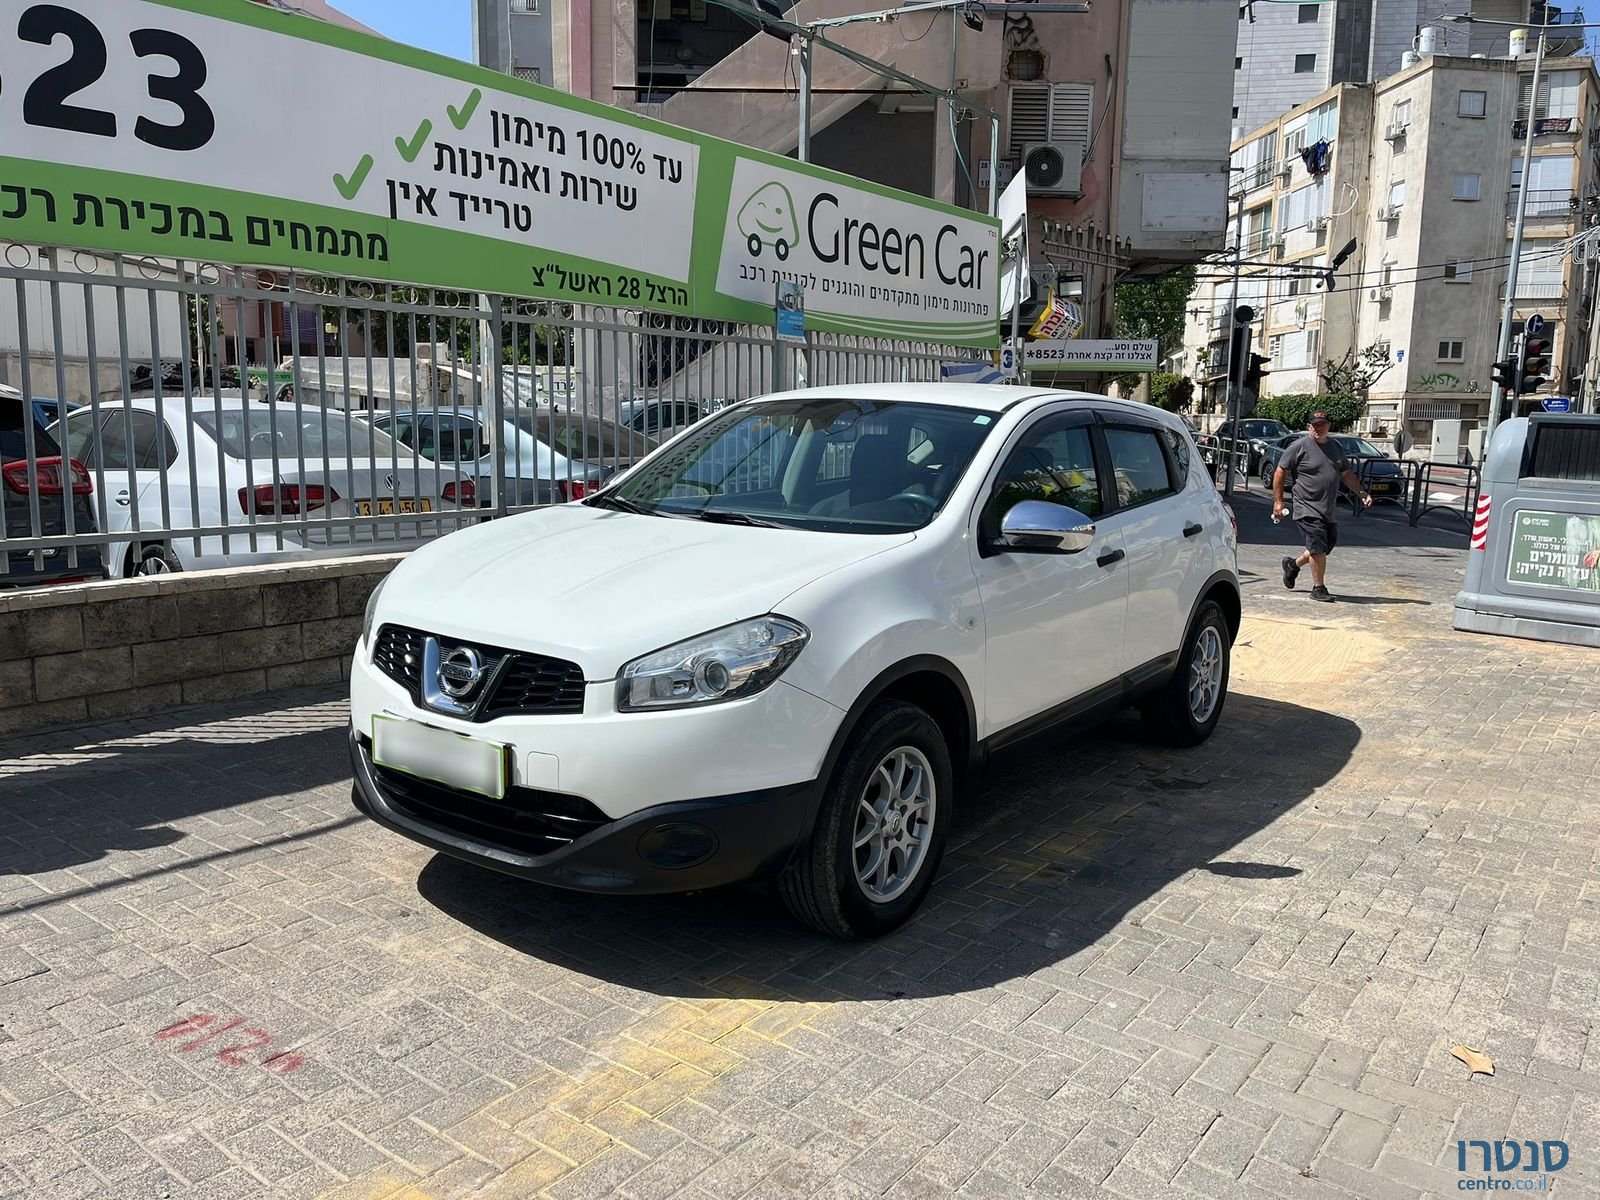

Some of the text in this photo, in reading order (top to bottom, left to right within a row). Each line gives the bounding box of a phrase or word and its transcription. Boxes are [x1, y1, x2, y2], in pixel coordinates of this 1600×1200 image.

[490, 109, 683, 184] עד 100% מימון
[433, 141, 637, 212] שירות ואמינות
[386, 178, 532, 232] טרייד אין
[72, 192, 234, 242] במכירת
[245, 215, 389, 261] מתמחים
[807, 192, 989, 290] Green Car
[739, 263, 767, 283] רכב
[617, 275, 640, 300] 28
[645, 278, 688, 306] הרצל
[822, 278, 866, 298] והוגנים
[869, 286, 920, 308] מתקדמים
[923, 294, 950, 311] מימון
[952, 299, 989, 316] פתרונות
[1115, 352, 1125, 360] זה
[1127, 351, 1152, 360] אצלנו
[1132, 341, 1153, 351] שלם
[1067, 352, 1092, 361] אחרת
[1093, 352, 1113, 362] קצת
[1529, 550, 1580, 566] שומרים
[1515, 561, 1555, 578] נקייה!
